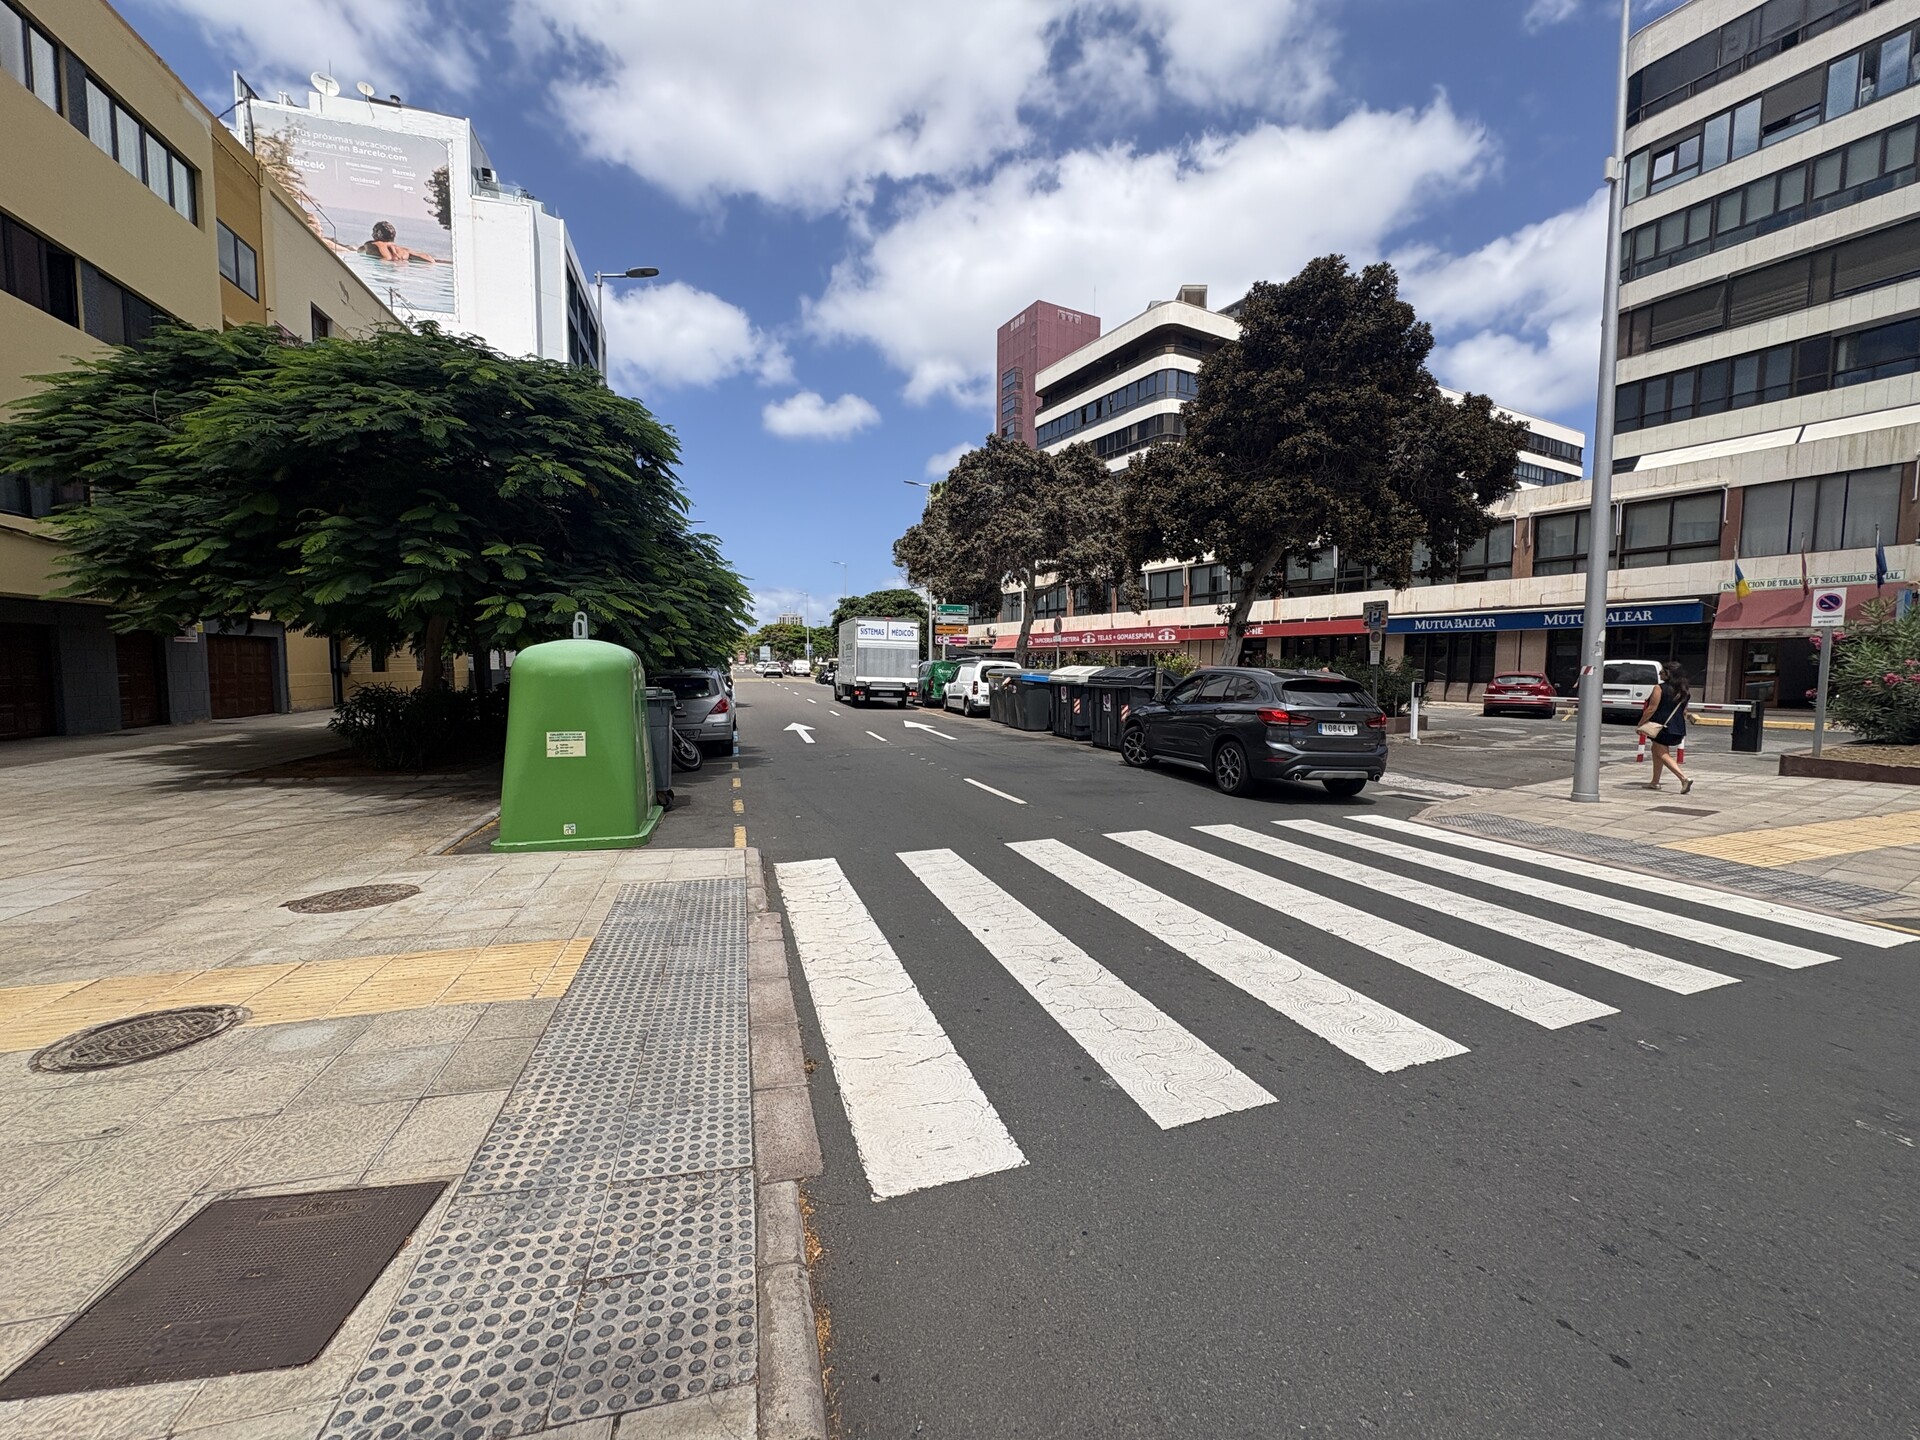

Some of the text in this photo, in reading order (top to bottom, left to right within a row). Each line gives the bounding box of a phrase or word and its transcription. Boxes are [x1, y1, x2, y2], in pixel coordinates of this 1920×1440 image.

[295, 128, 403, 154] Tus próximas vacaciones
[302, 138, 337, 150] esperan
[287, 156, 326, 170] Barceló
[1723, 571, 1900, 590] INSCION DE TRABAO Y SEGURIDAD SOIAL
[1415, 618, 1496, 630] MUTUA BALEAR
[1544, 610, 1653, 626] MUTU ALEAR
[860, 627, 915, 637] SISTEMAS MÉDICOS
[1117, 632, 1155, 641] GOMAESPUMA
[1324, 724, 1356, 733] 1084 LYF
